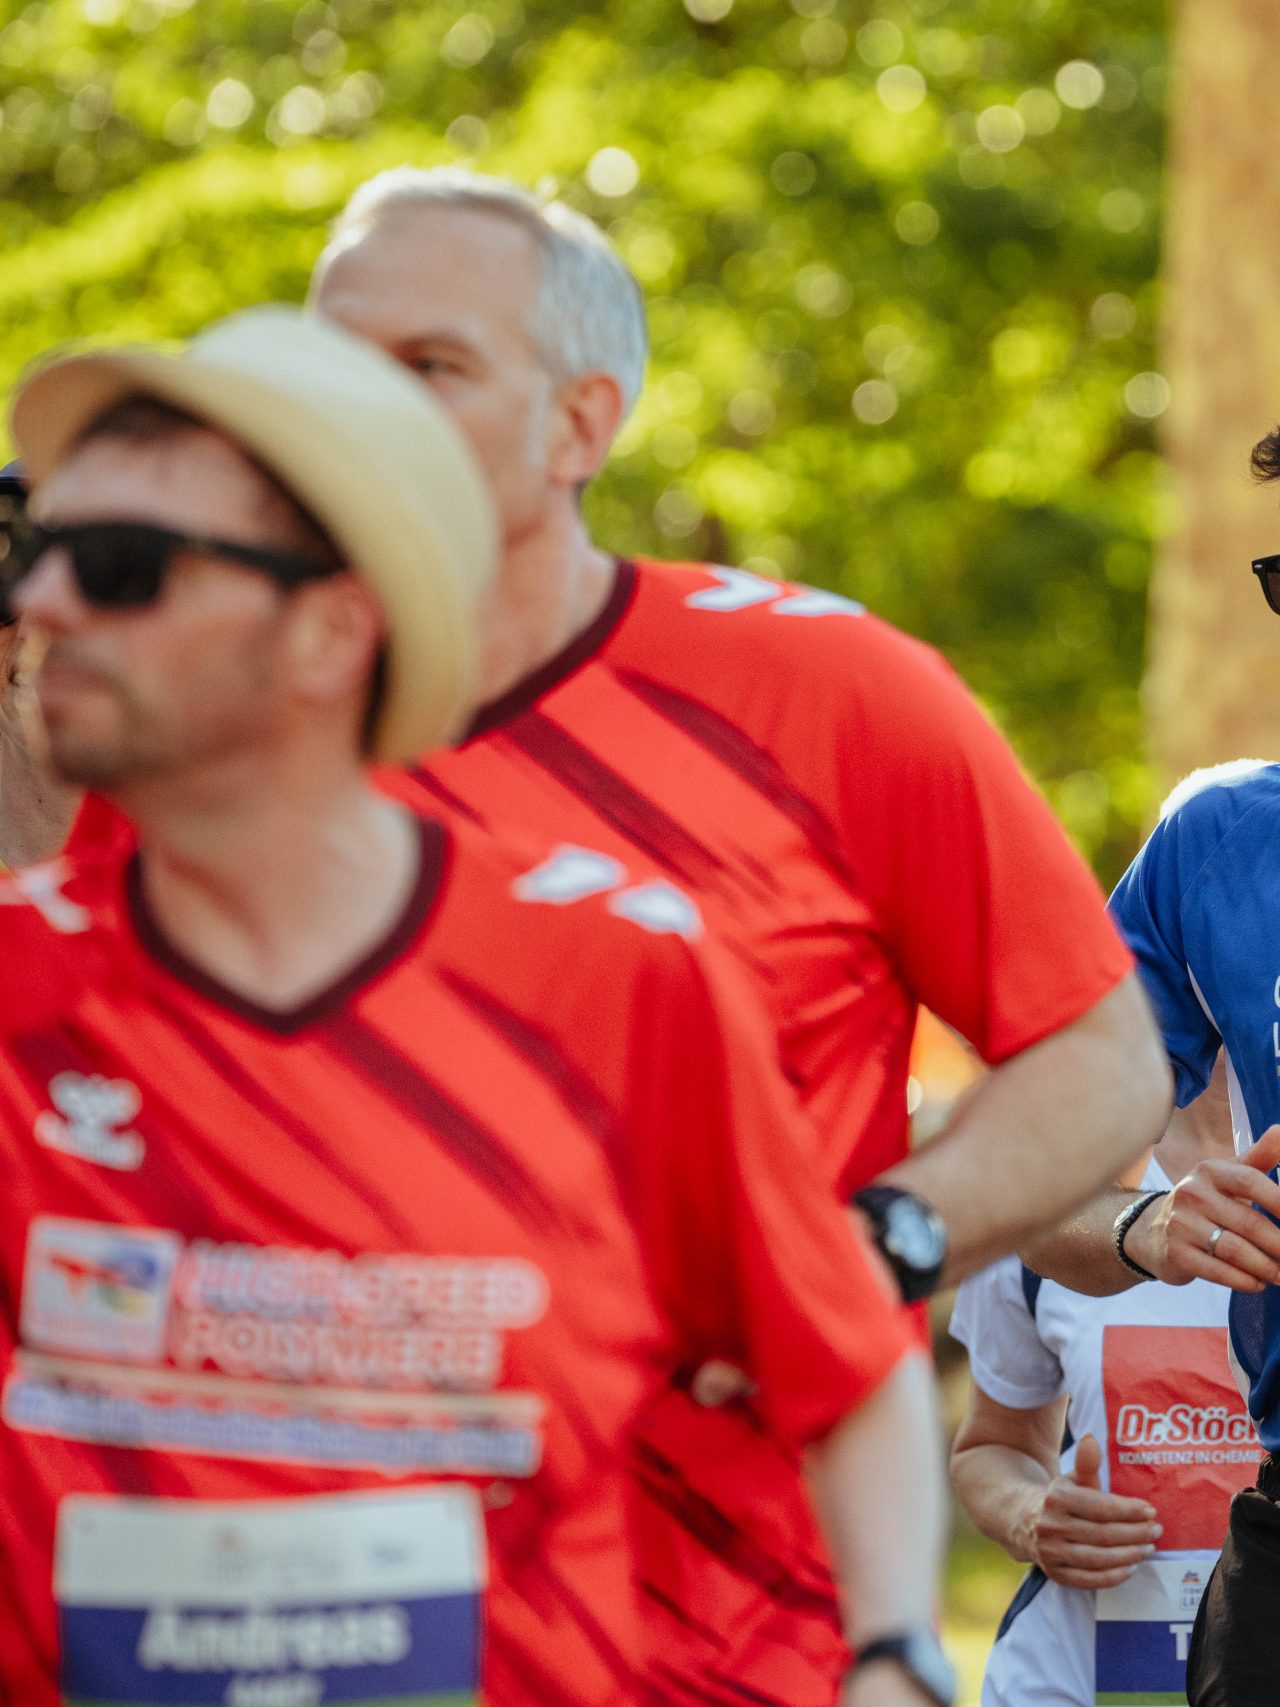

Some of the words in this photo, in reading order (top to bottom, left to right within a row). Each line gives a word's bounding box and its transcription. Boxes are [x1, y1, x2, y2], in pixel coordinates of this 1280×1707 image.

[1118, 1450, 1194, 1466] KOMPETENZ
[1195, 1450, 1209, 1465] IN
[1210, 1449, 1261, 1465] CHEMIE
[137, 1600, 411, 1671] Andreas
